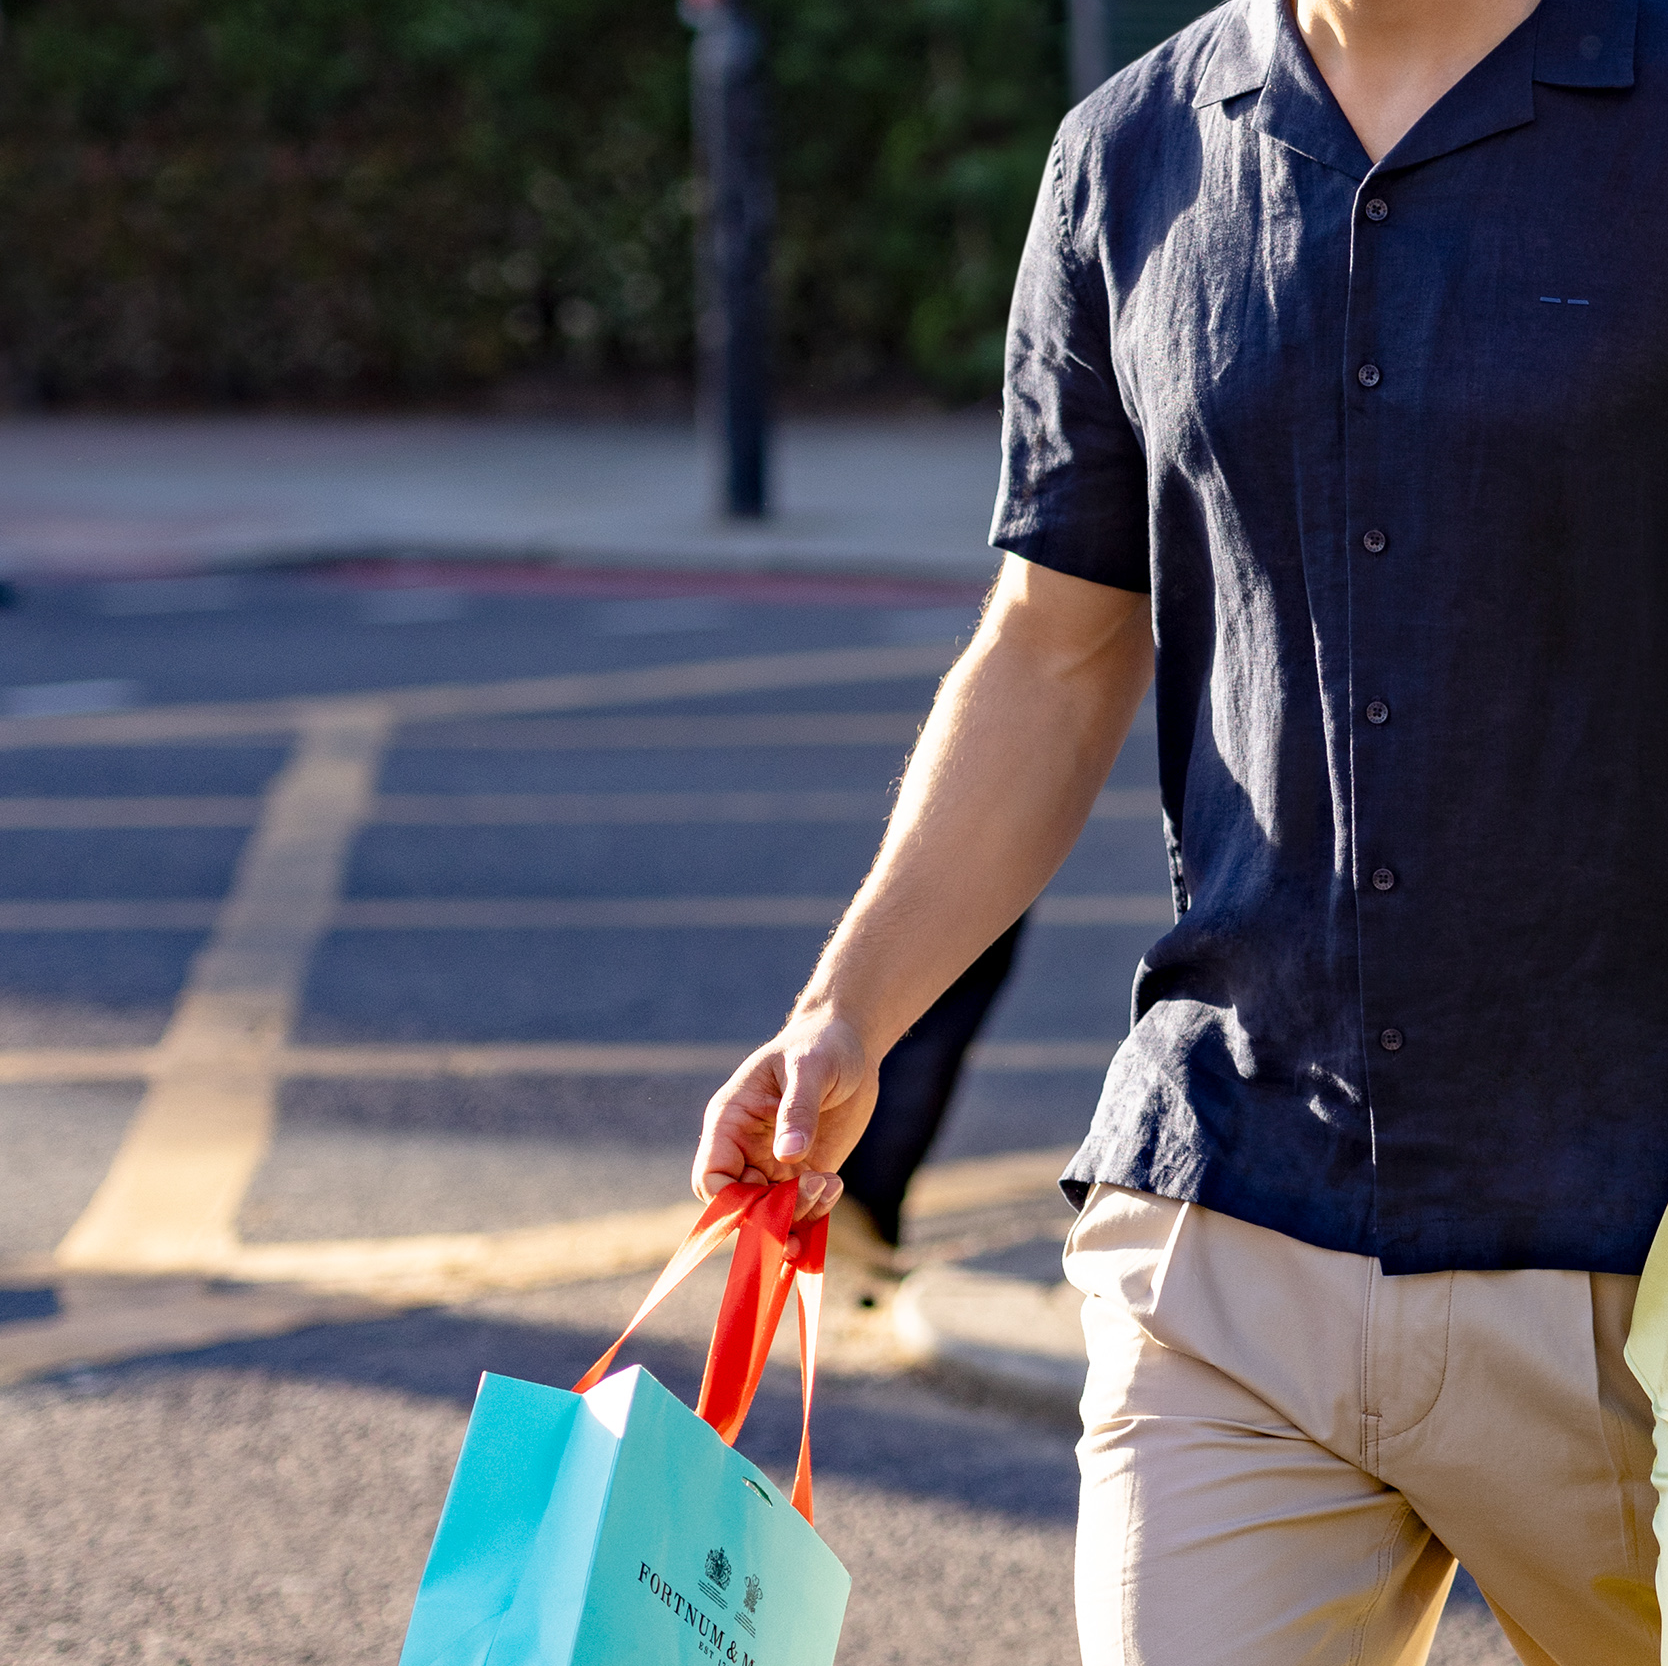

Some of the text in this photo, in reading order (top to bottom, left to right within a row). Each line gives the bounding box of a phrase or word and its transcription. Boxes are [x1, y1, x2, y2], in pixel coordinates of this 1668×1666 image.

[637, 1560, 726, 1652] FORTNUM
[726, 1640, 738, 1664] &
[698, 1640, 715, 1660] EST
